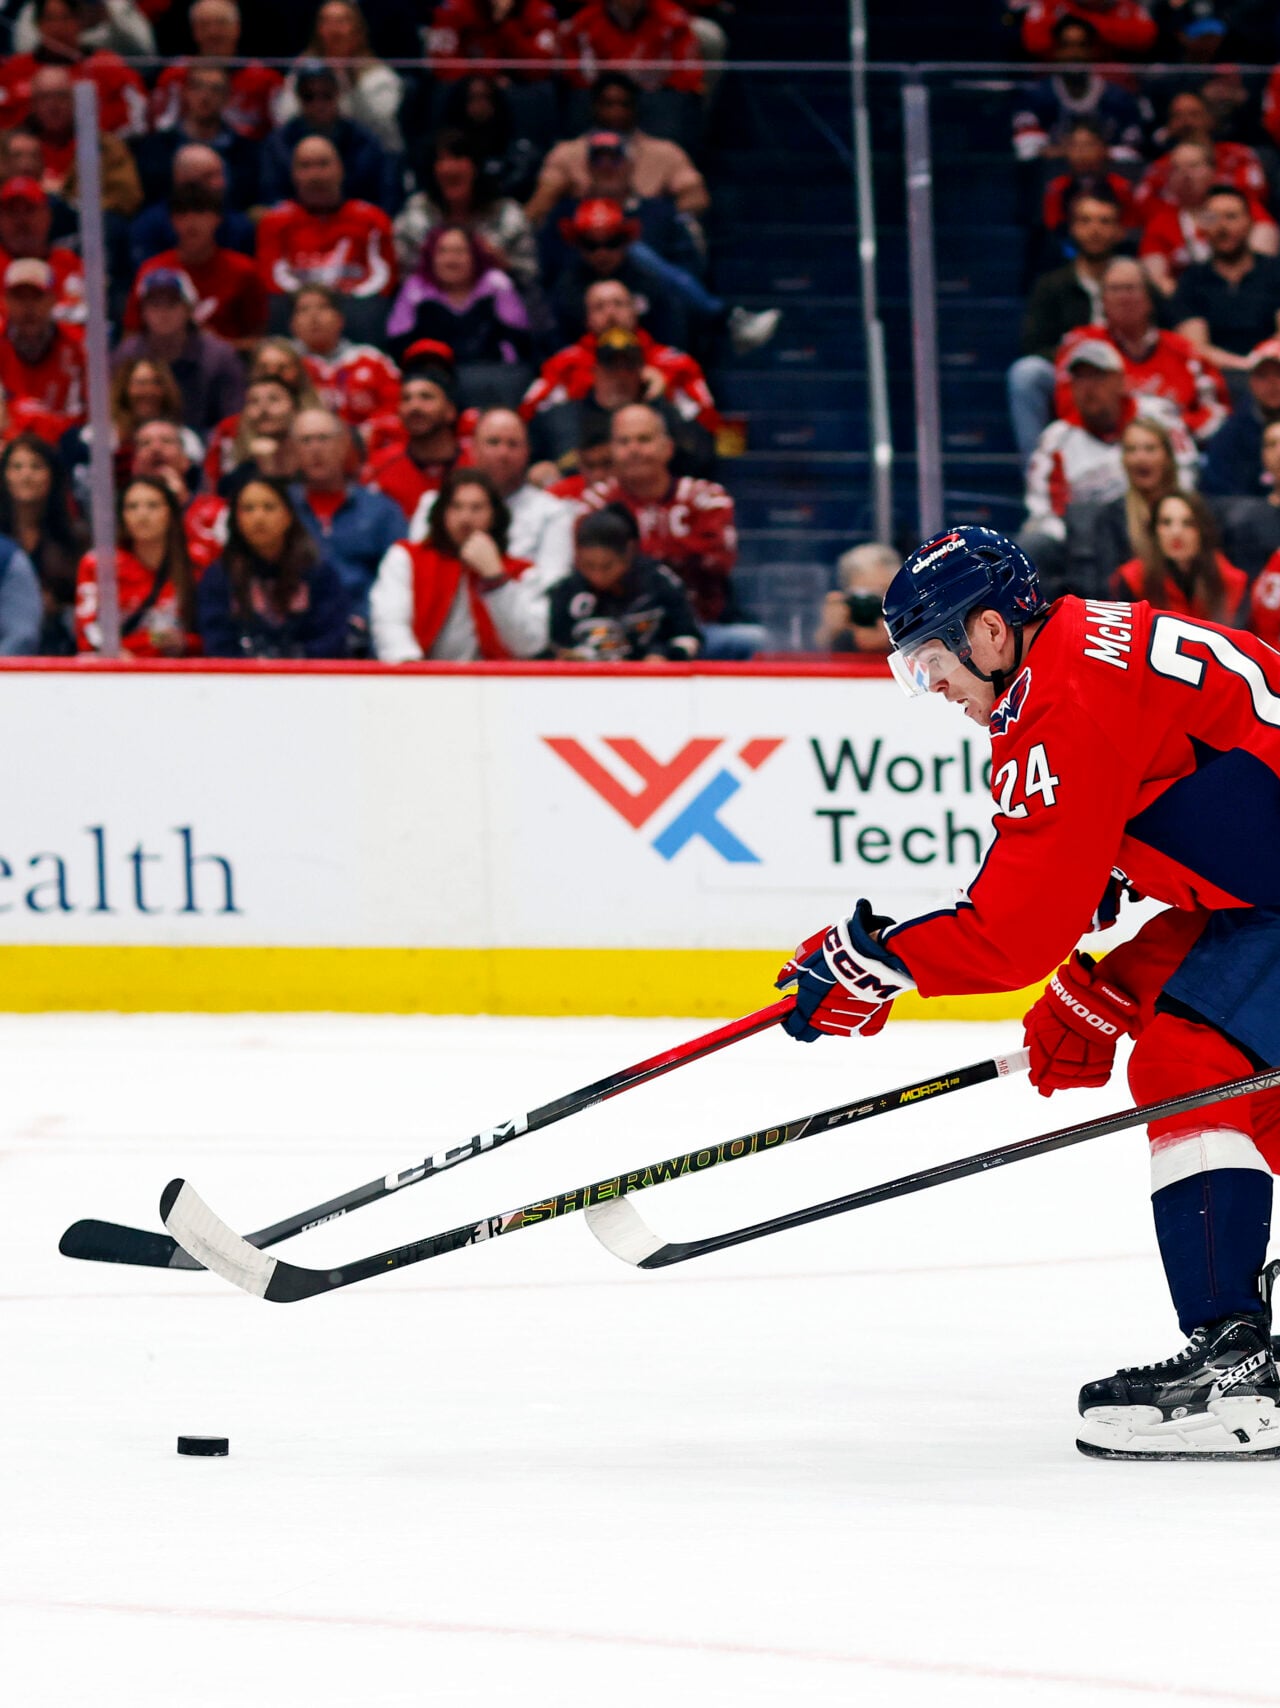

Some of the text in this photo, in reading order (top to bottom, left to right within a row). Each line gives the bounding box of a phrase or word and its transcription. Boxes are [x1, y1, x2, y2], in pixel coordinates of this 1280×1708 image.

[994, 743, 1060, 819] 24
[815, 808, 982, 864] Tech
[824, 926, 903, 999] CCM
[384, 1112, 529, 1191] CCM
[520, 1126, 790, 1228] SHERWOOD
[899, 1078, 950, 1103] MORPH
[1216, 1355, 1262, 1392] CCM
